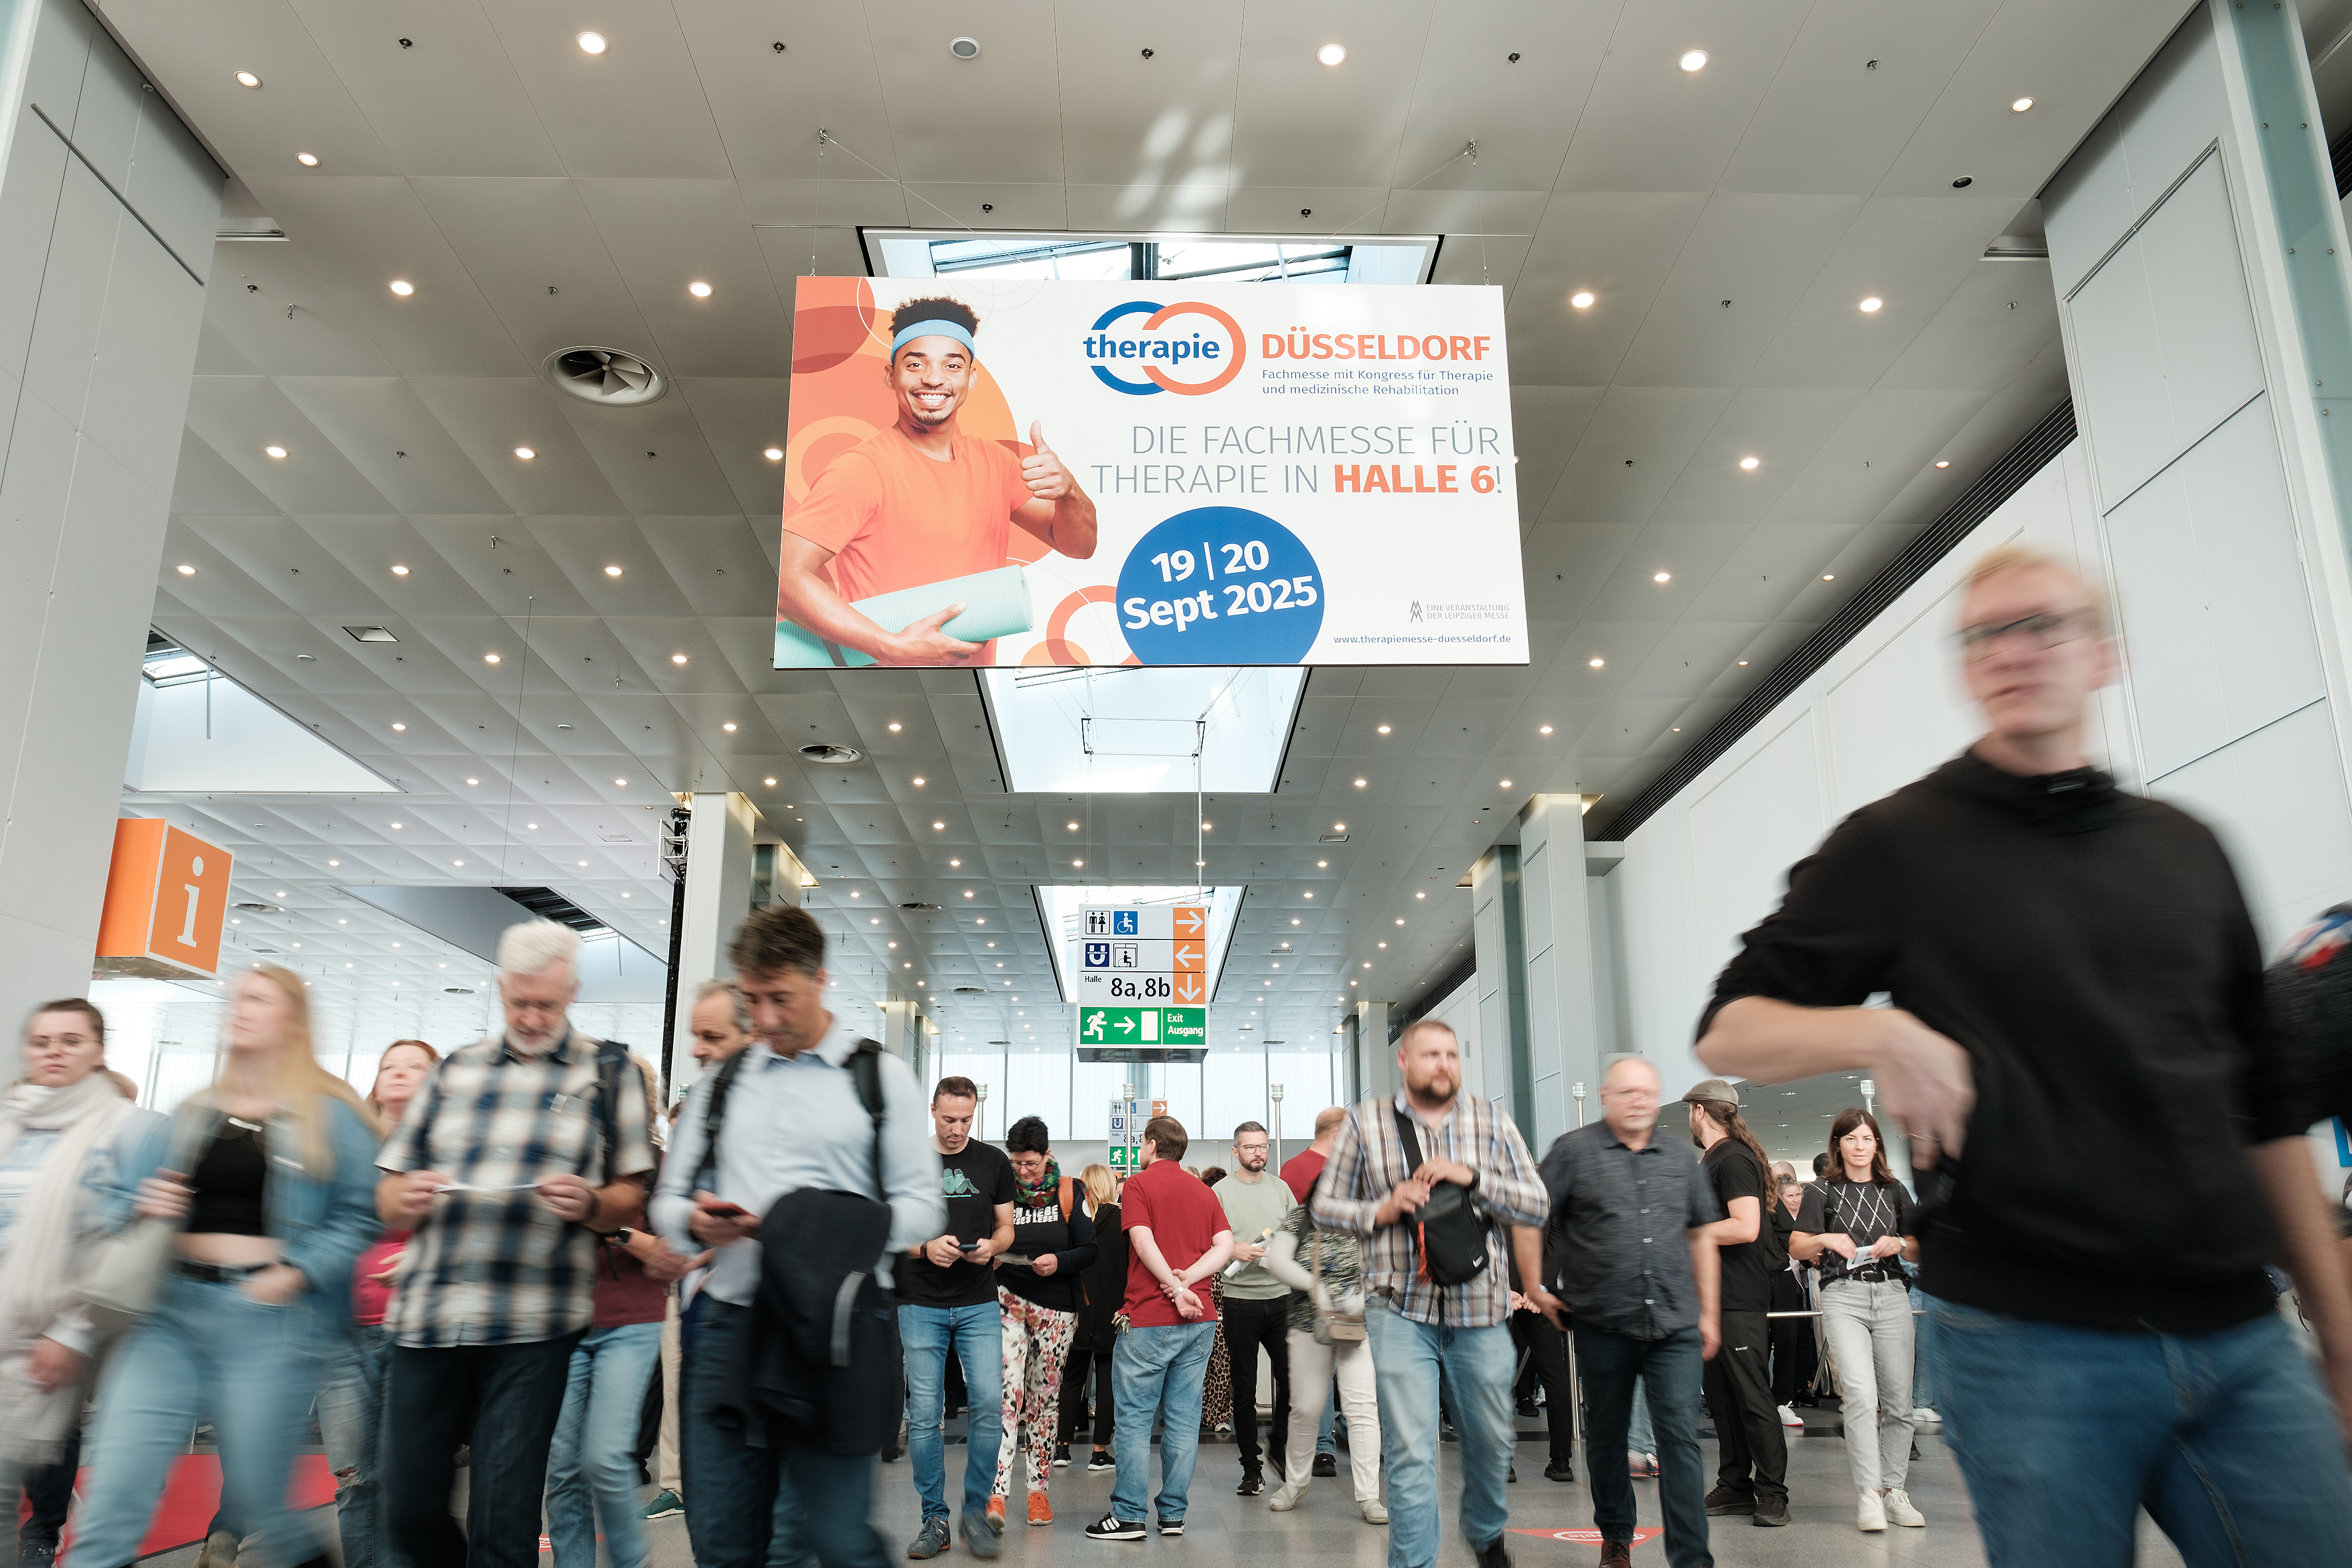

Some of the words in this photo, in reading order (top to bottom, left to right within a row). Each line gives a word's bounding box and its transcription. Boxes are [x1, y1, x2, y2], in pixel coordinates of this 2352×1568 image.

[1083, 333, 1220, 365] therapie
[1262, 326, 1491, 361] DÜSSELDORF
[1262, 369, 1330, 380] Fachmesse
[1334, 369, 1354, 380] mit
[1358, 370, 1414, 382] Kongress
[1418, 370, 1436, 380] für
[1439, 370, 1494, 383] Therapie
[1263, 384, 1285, 394] und
[1290, 384, 1369, 394] medizinische
[1373, 384, 1459, 395] Rehabilitation
[1133, 426, 1187, 454] DIE
[1204, 426, 1415, 455] FACHMESSE
[1431, 420, 1501, 455] FÜR
[1091, 465, 1268, 493] THERAPIE
[1285, 465, 1318, 493] IN
[1334, 464, 1459, 493] HALLE
[1470, 465, 1502, 494] 6!
[1150, 550, 1196, 583] 19
[1219, 540, 1269, 574] 20
[1123, 589, 1219, 633] Sept
[1222, 575, 1318, 617] 2025
[1333, 634, 1512, 645] www.therapiemesse-duesseldorf.de
[1111, 977, 1170, 1000] 8a,8b
[1167, 1013, 1184, 1023] Exit
[1167, 1025, 1204, 1037] Ausgang
